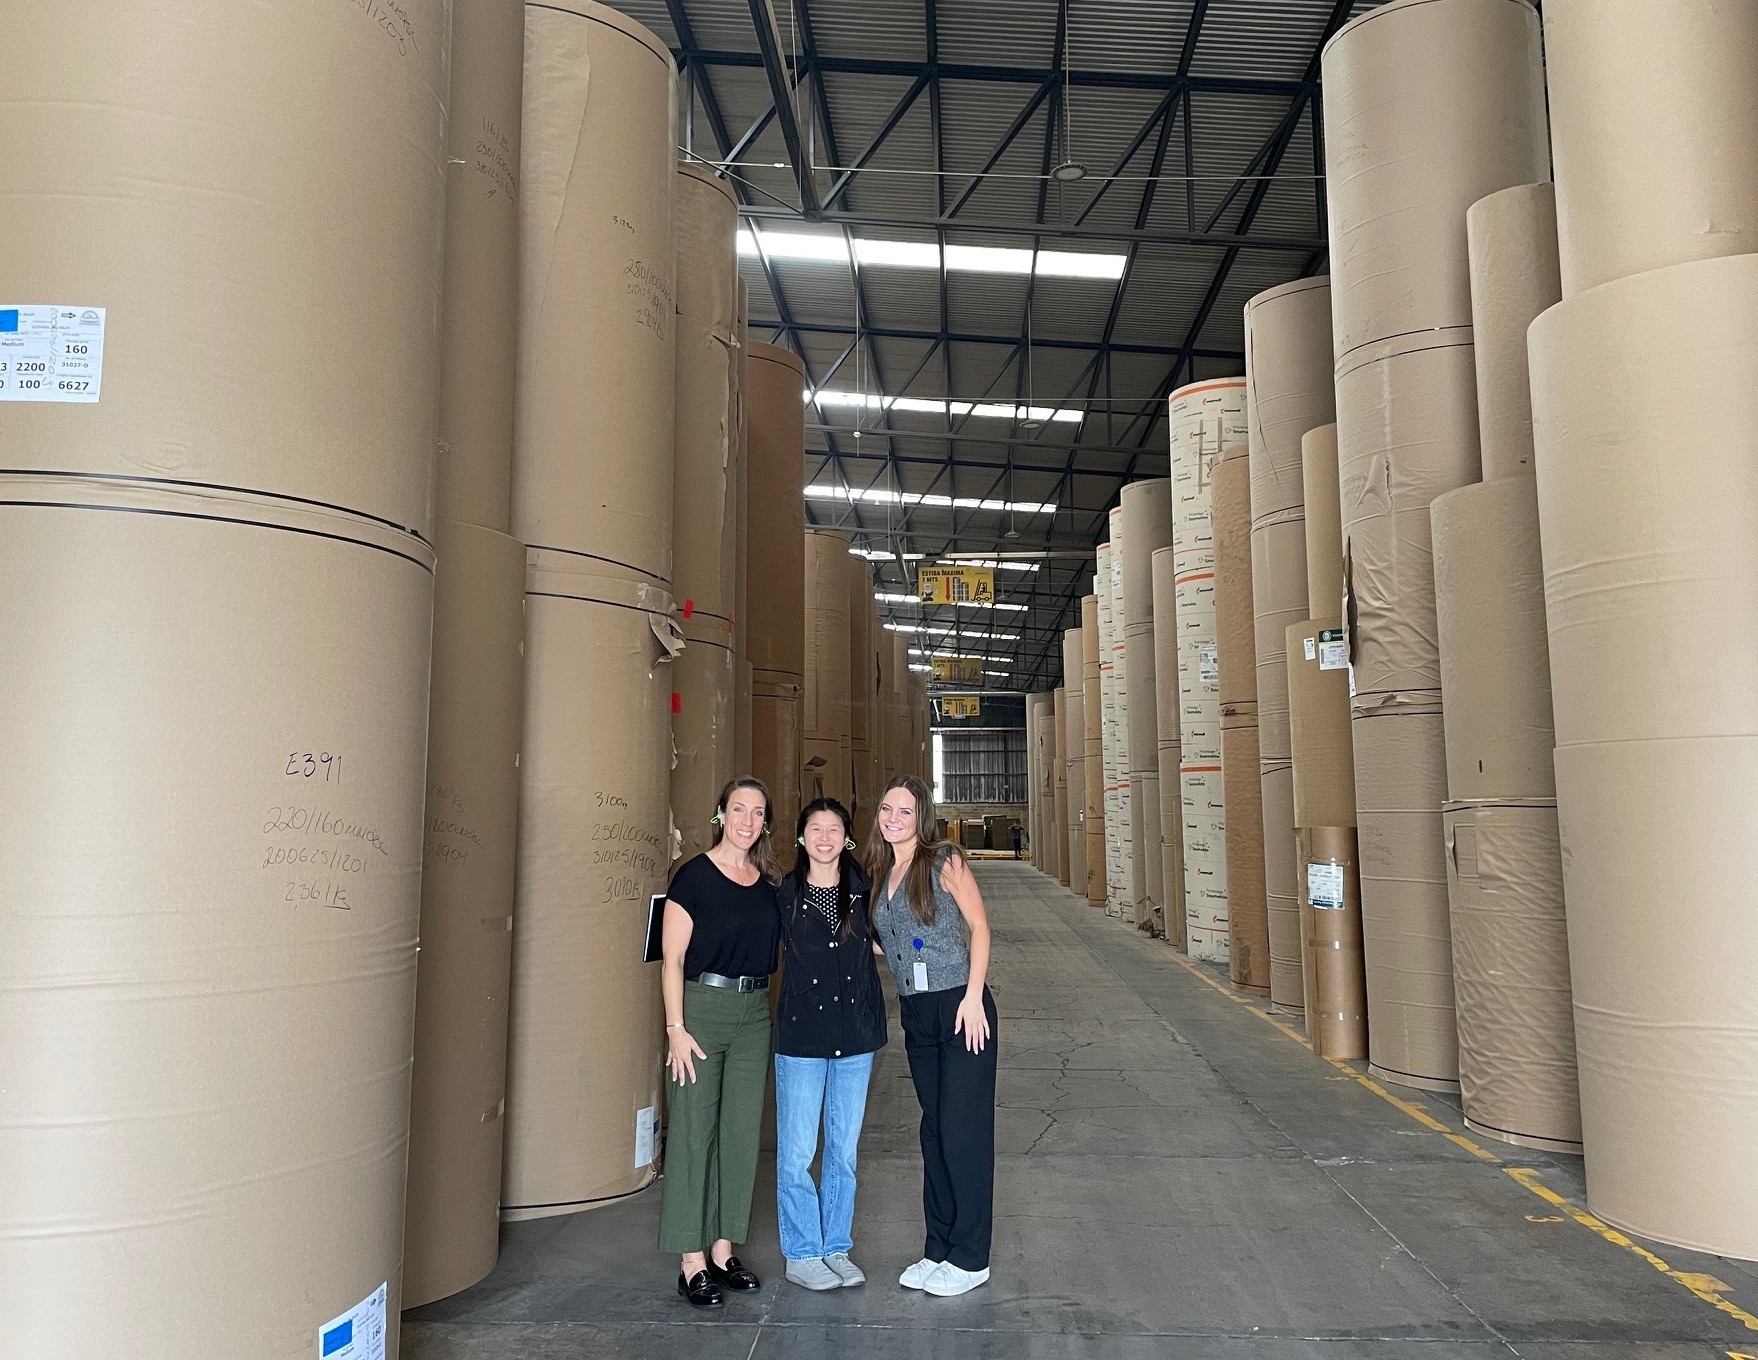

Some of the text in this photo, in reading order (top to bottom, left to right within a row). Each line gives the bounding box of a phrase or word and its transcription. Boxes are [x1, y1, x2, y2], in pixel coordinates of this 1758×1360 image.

[65, 345, 88, 354] 160
[16, 362, 46, 372] 2200
[18, 380, 41, 389] 100
[58, 381, 89, 391] 6627
[286, 751, 342, 785] E391
